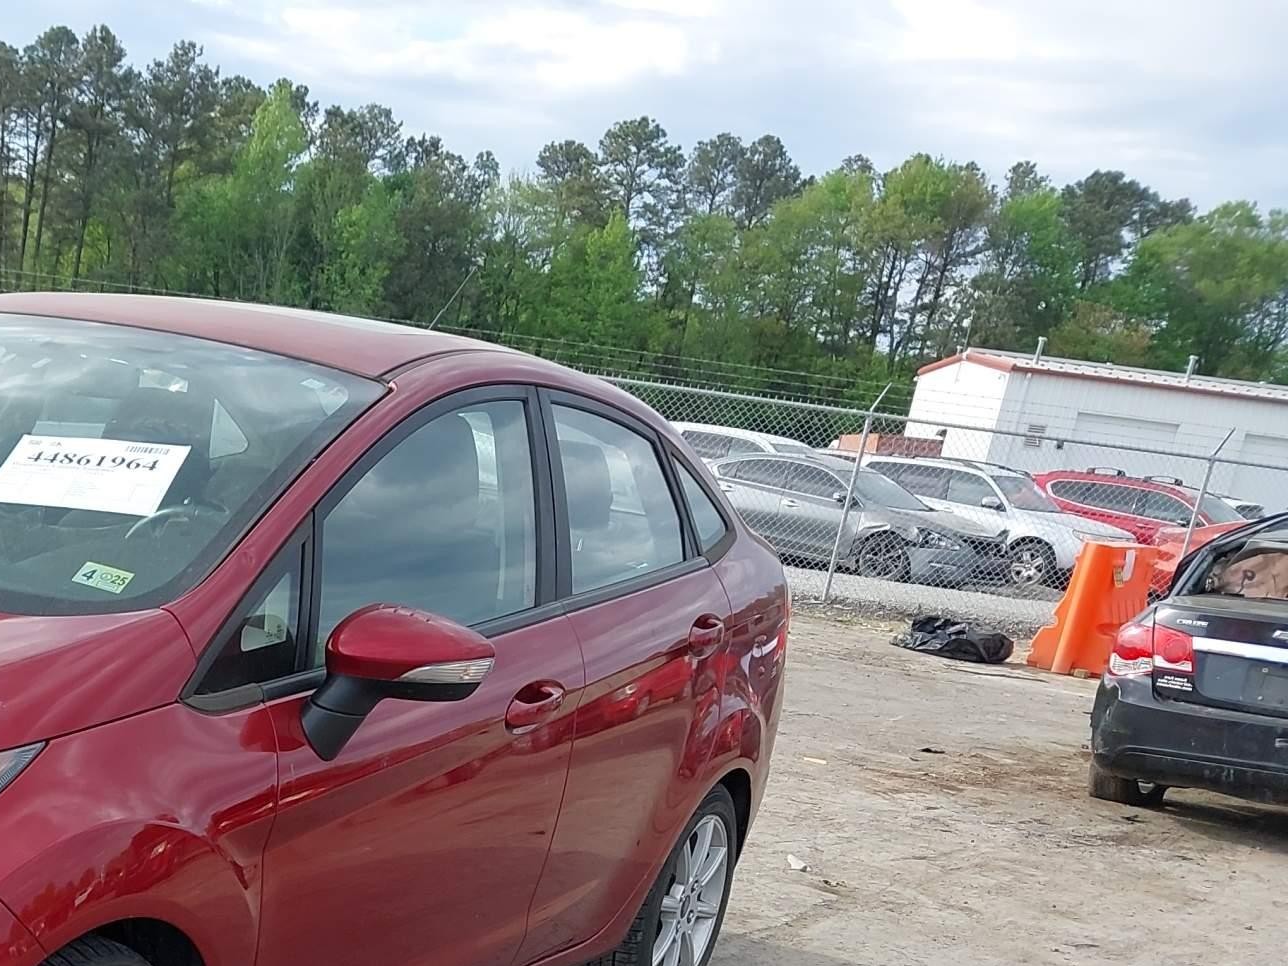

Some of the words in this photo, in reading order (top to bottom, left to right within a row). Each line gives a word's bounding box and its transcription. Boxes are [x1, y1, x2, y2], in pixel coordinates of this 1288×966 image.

[27, 450, 160, 472] 44861964
[81, 568, 98, 581] 4
[109, 574, 129, 586] 25
